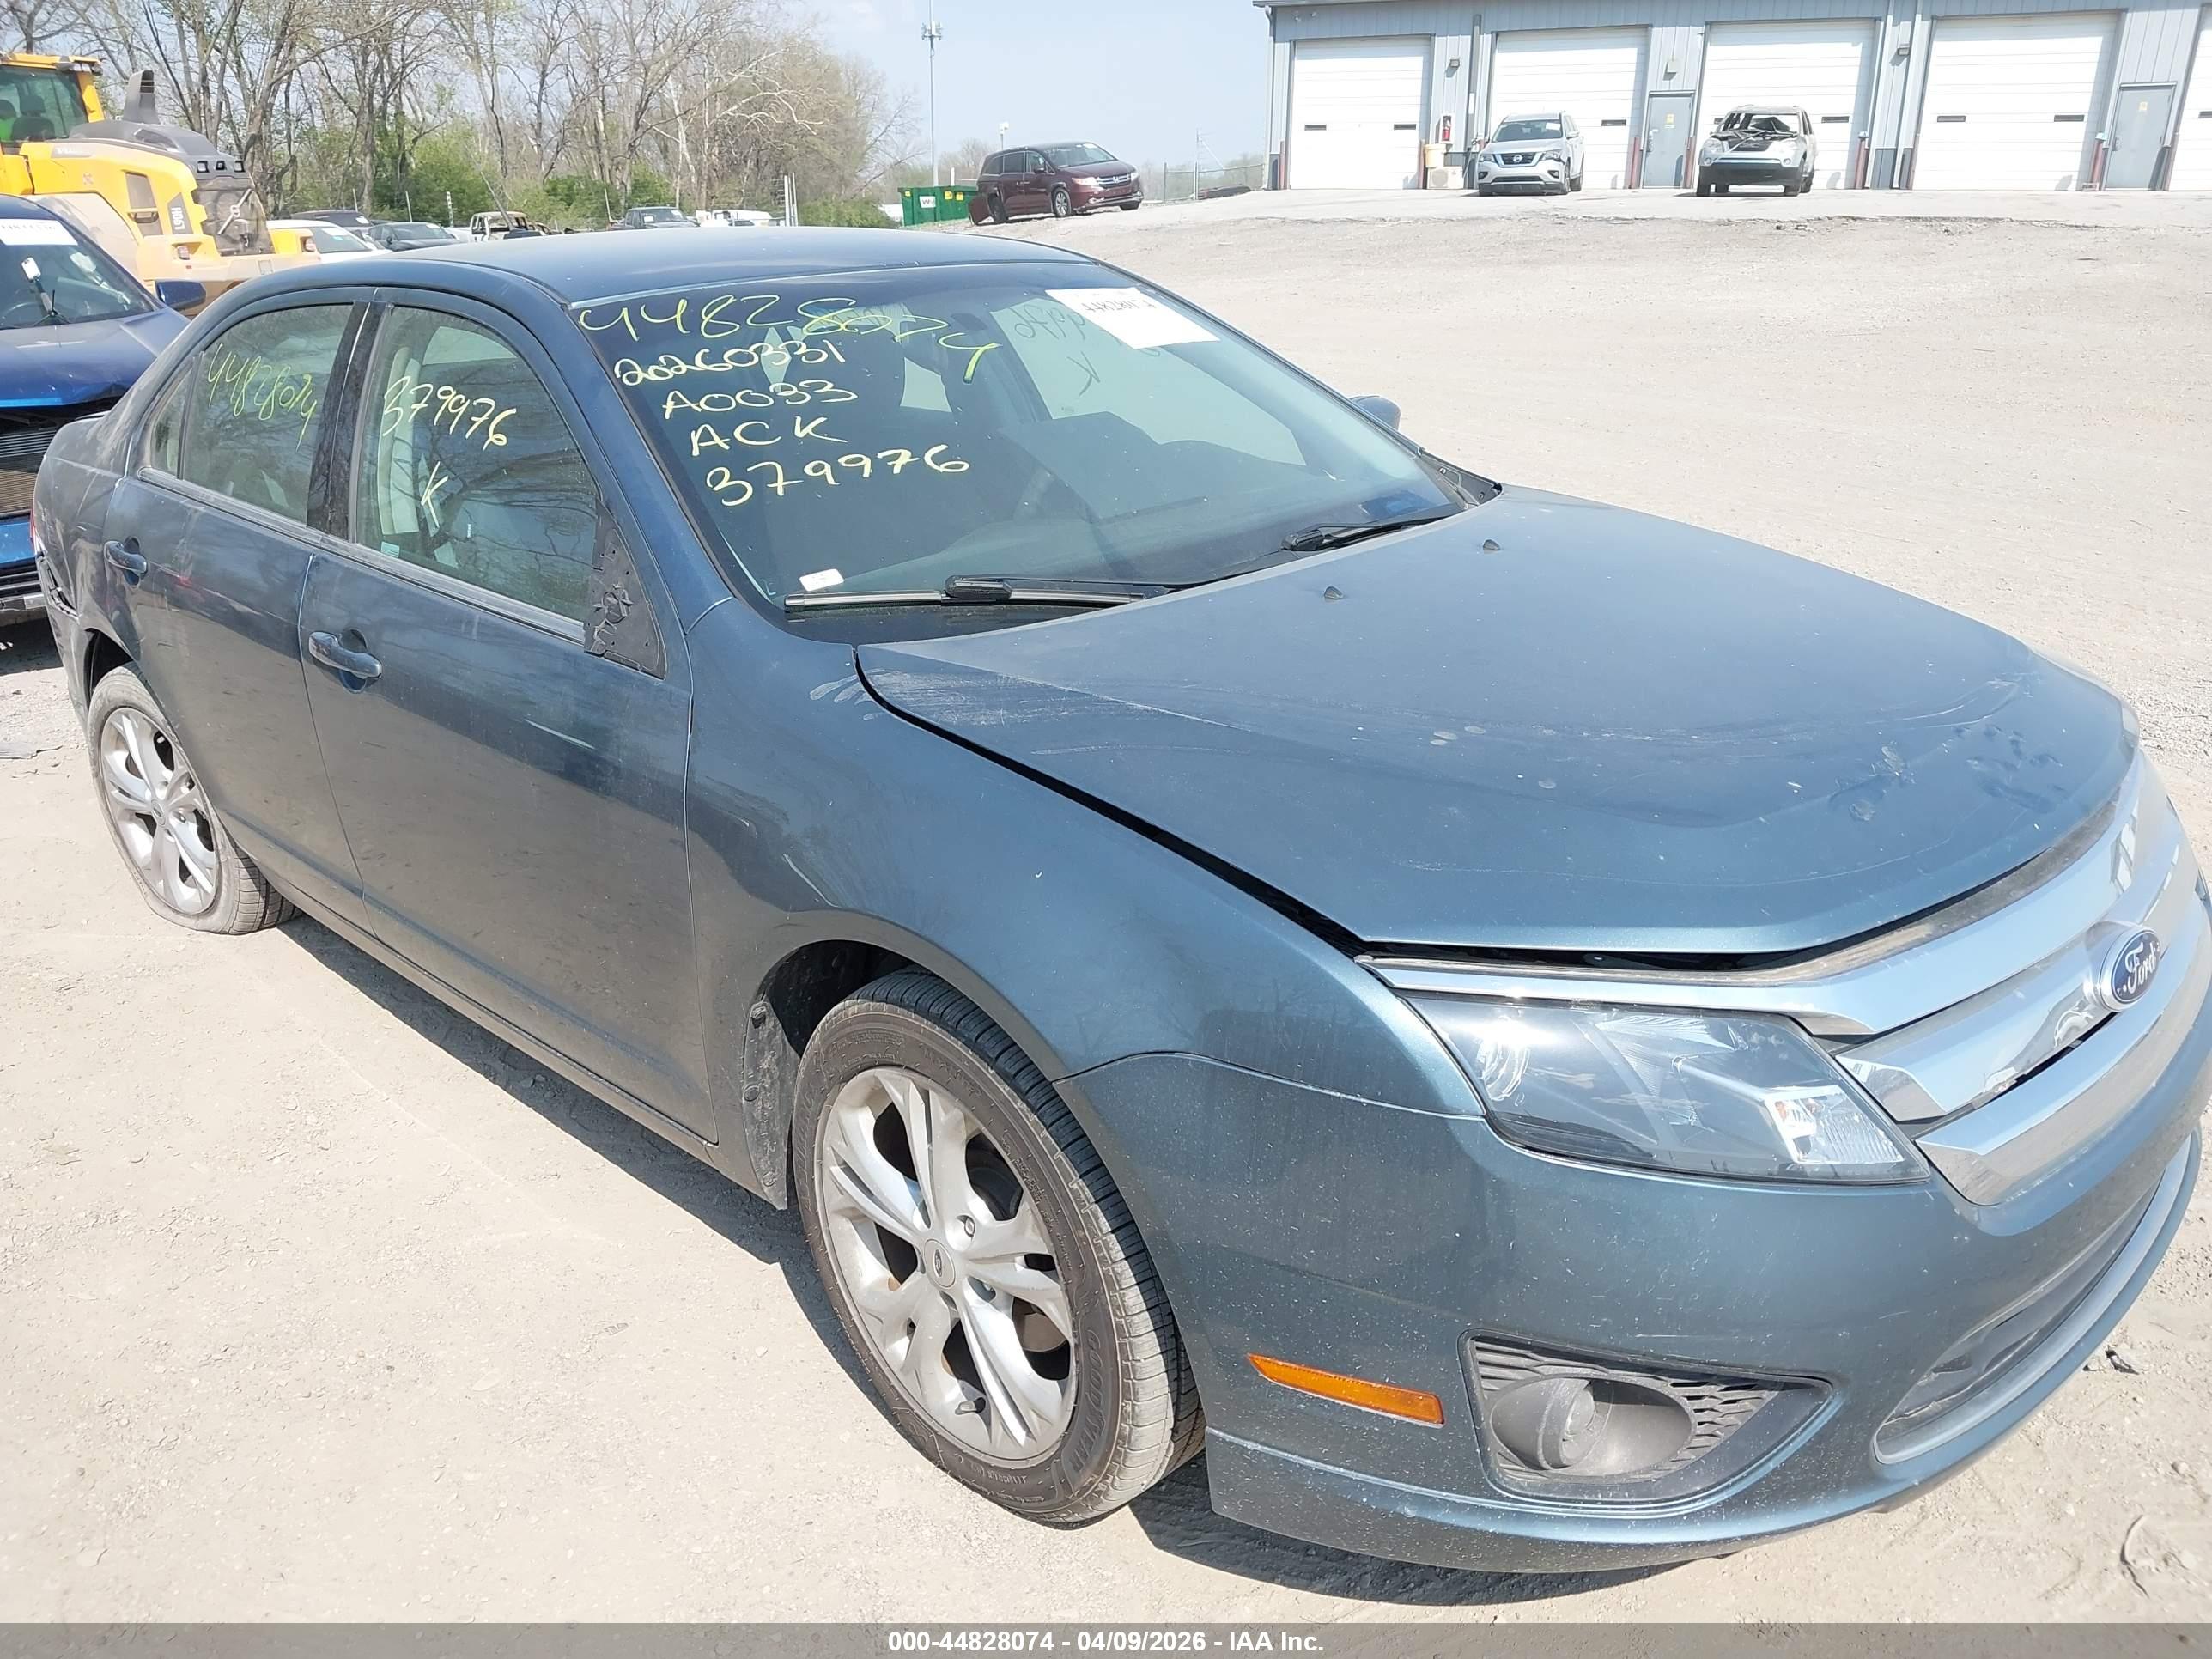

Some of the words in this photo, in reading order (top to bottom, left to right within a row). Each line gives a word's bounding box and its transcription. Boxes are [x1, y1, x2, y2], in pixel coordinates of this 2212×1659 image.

[615, 340, 846, 386] 20260331
[382, 375, 517, 451] 379976
[661, 379, 858, 419] A0033
[421, 461, 450, 529] K
[706, 444, 970, 507] 379976
[2124, 941, 2157, 994] Ford
[1071, 1329, 1107, 1474] GOODYEAR
